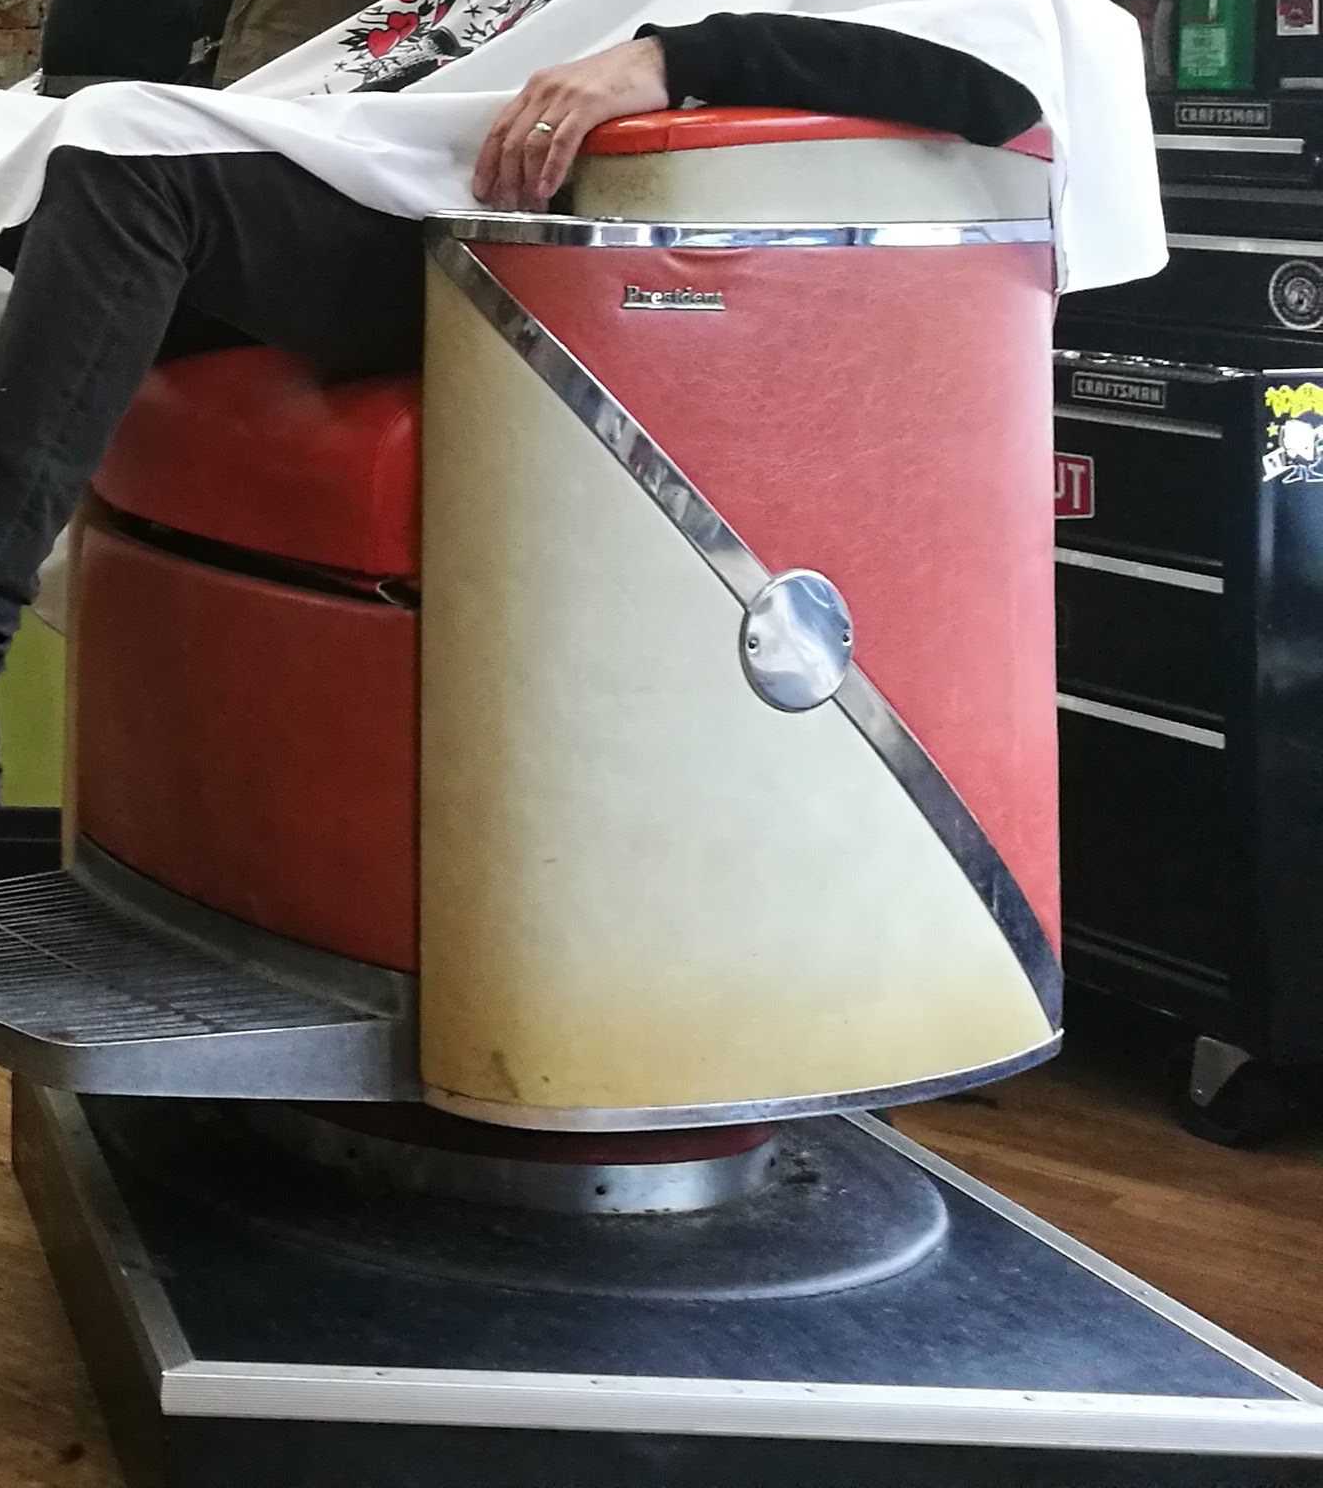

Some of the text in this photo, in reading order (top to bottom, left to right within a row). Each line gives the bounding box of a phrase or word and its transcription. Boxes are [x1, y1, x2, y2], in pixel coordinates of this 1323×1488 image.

[1181, 107, 1265, 123] CRAFTSMAN
[625, 285, 724, 306] President
[1076, 380, 1161, 402] CRAFTSMAN
